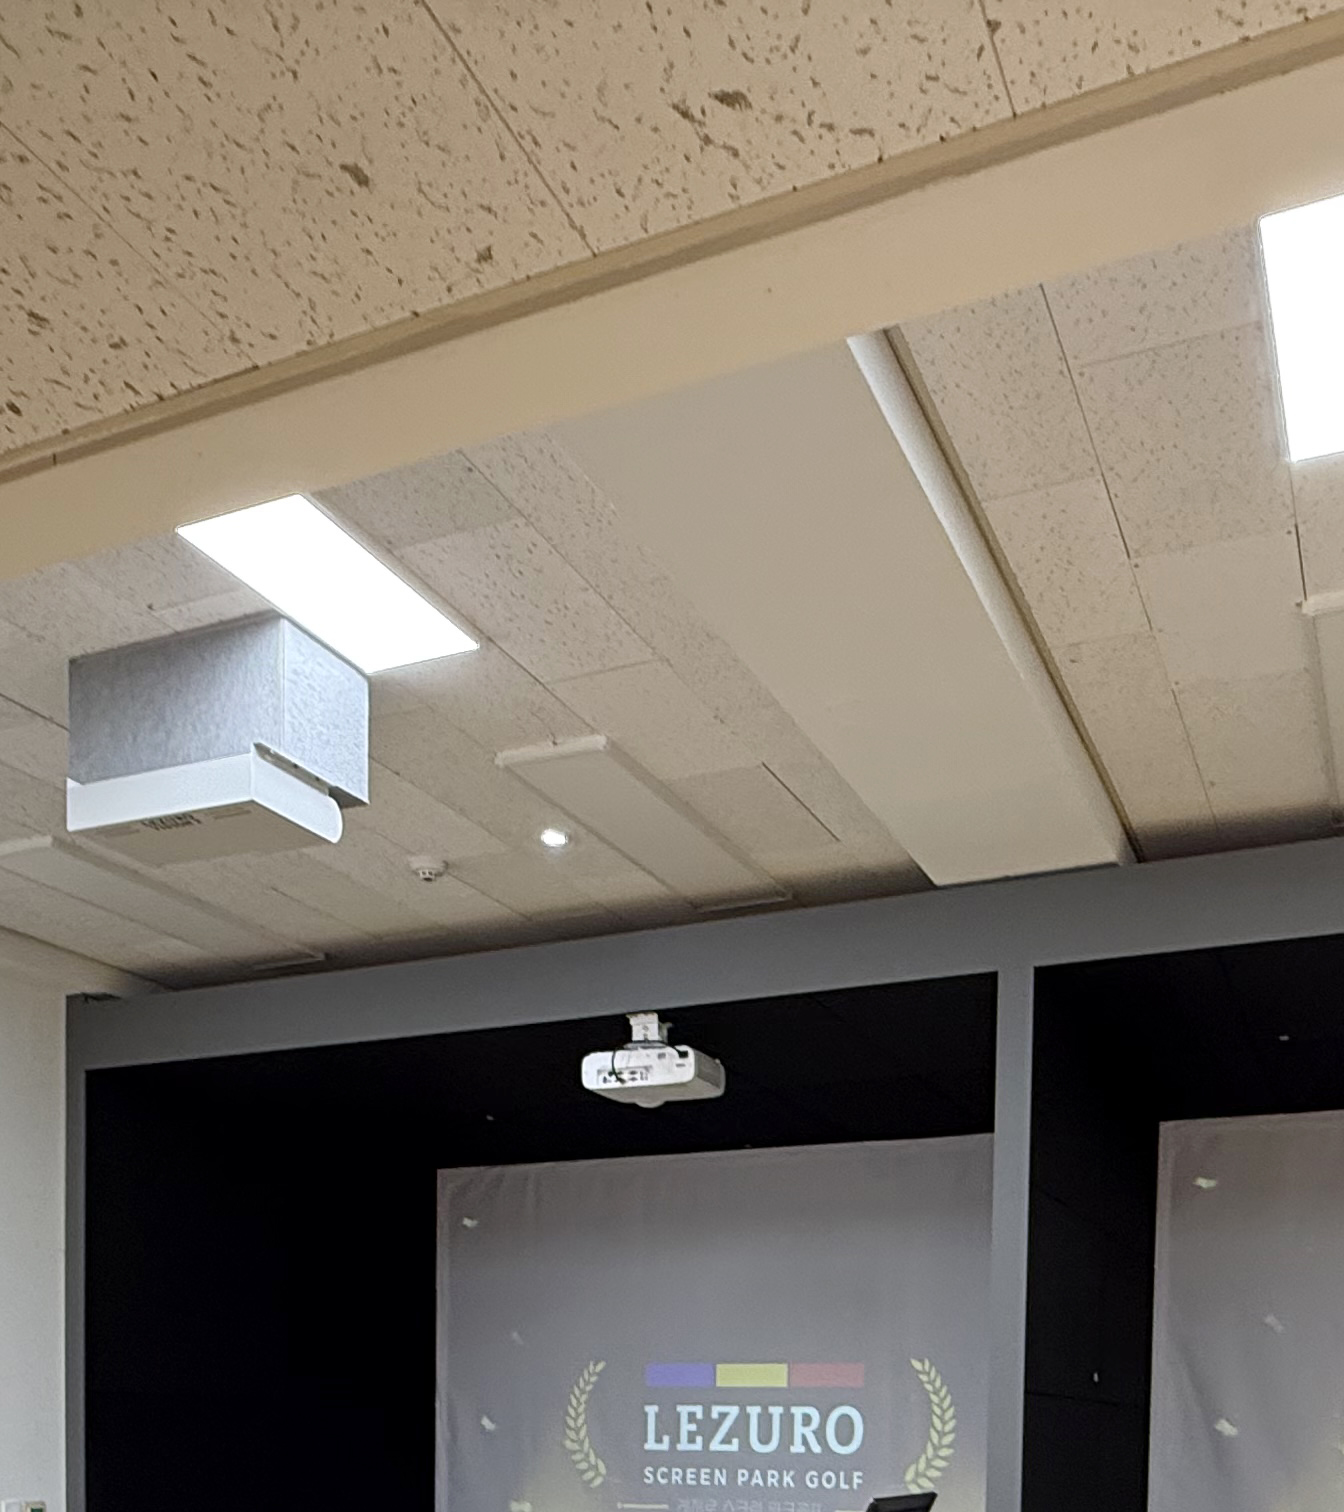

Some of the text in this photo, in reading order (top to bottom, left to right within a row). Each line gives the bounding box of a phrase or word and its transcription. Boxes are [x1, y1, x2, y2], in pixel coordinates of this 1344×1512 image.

[643, 1404, 865, 1456] LEZURO
[643, 1466, 864, 1491] SCREEN PARK GOLF
